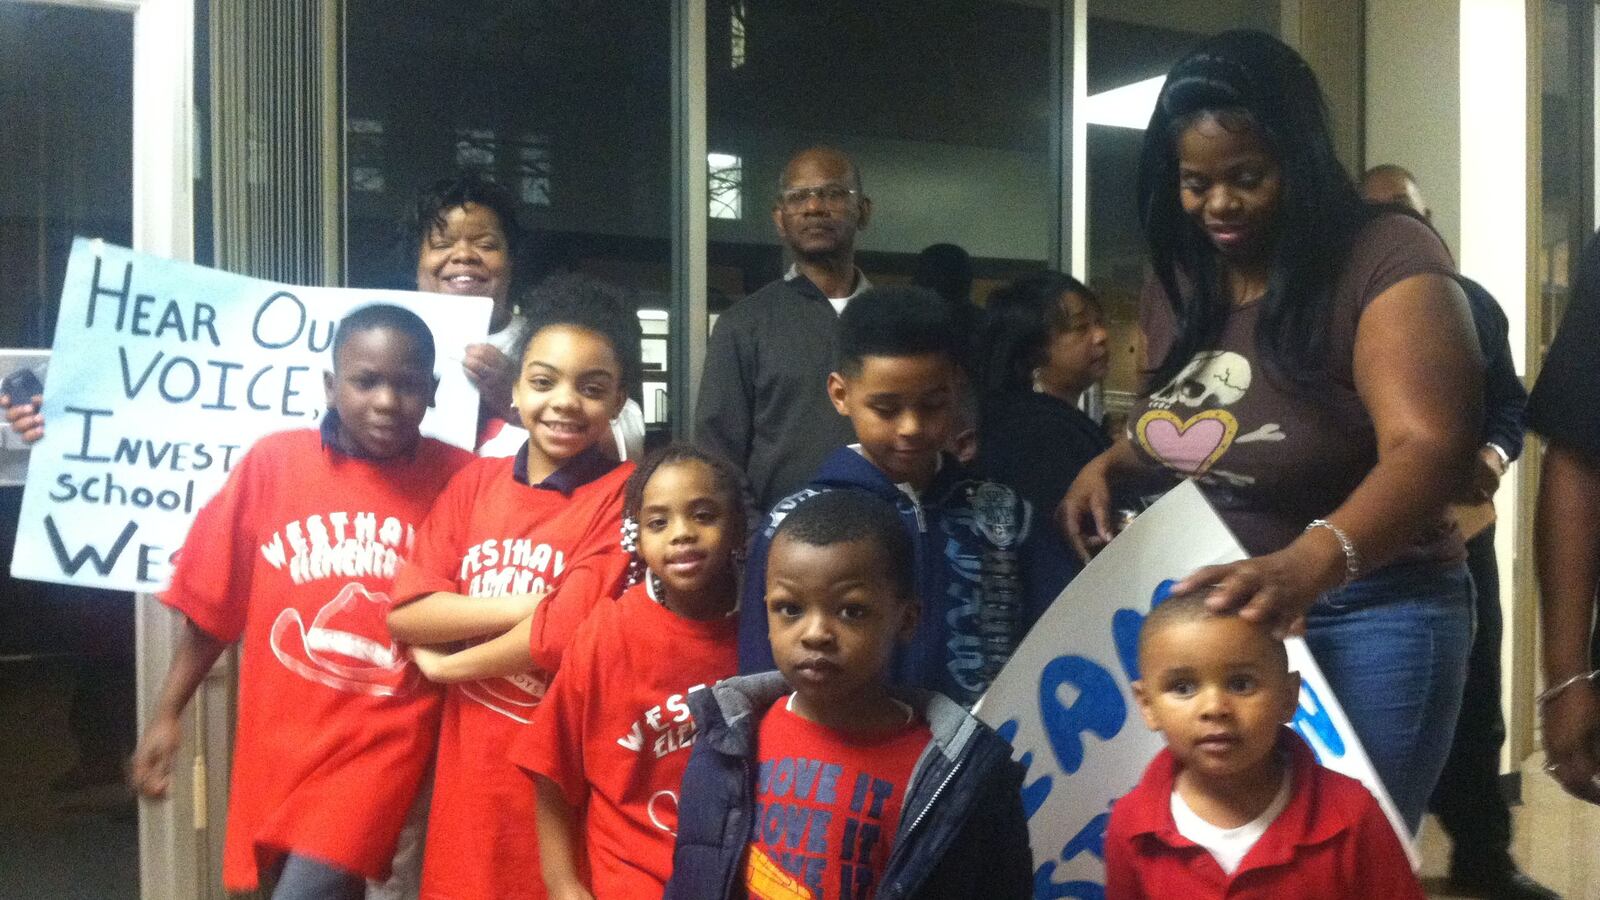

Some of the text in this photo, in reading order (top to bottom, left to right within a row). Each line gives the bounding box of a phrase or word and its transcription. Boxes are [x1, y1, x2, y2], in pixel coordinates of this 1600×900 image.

[86, 256, 334, 354] HEAR OU
[118, 345, 320, 420] VOICE,
[63, 405, 241, 474] INVEST
[43, 515, 181, 584] WE
[851, 772, 895, 819] IT
[842, 817, 881, 864] IT
